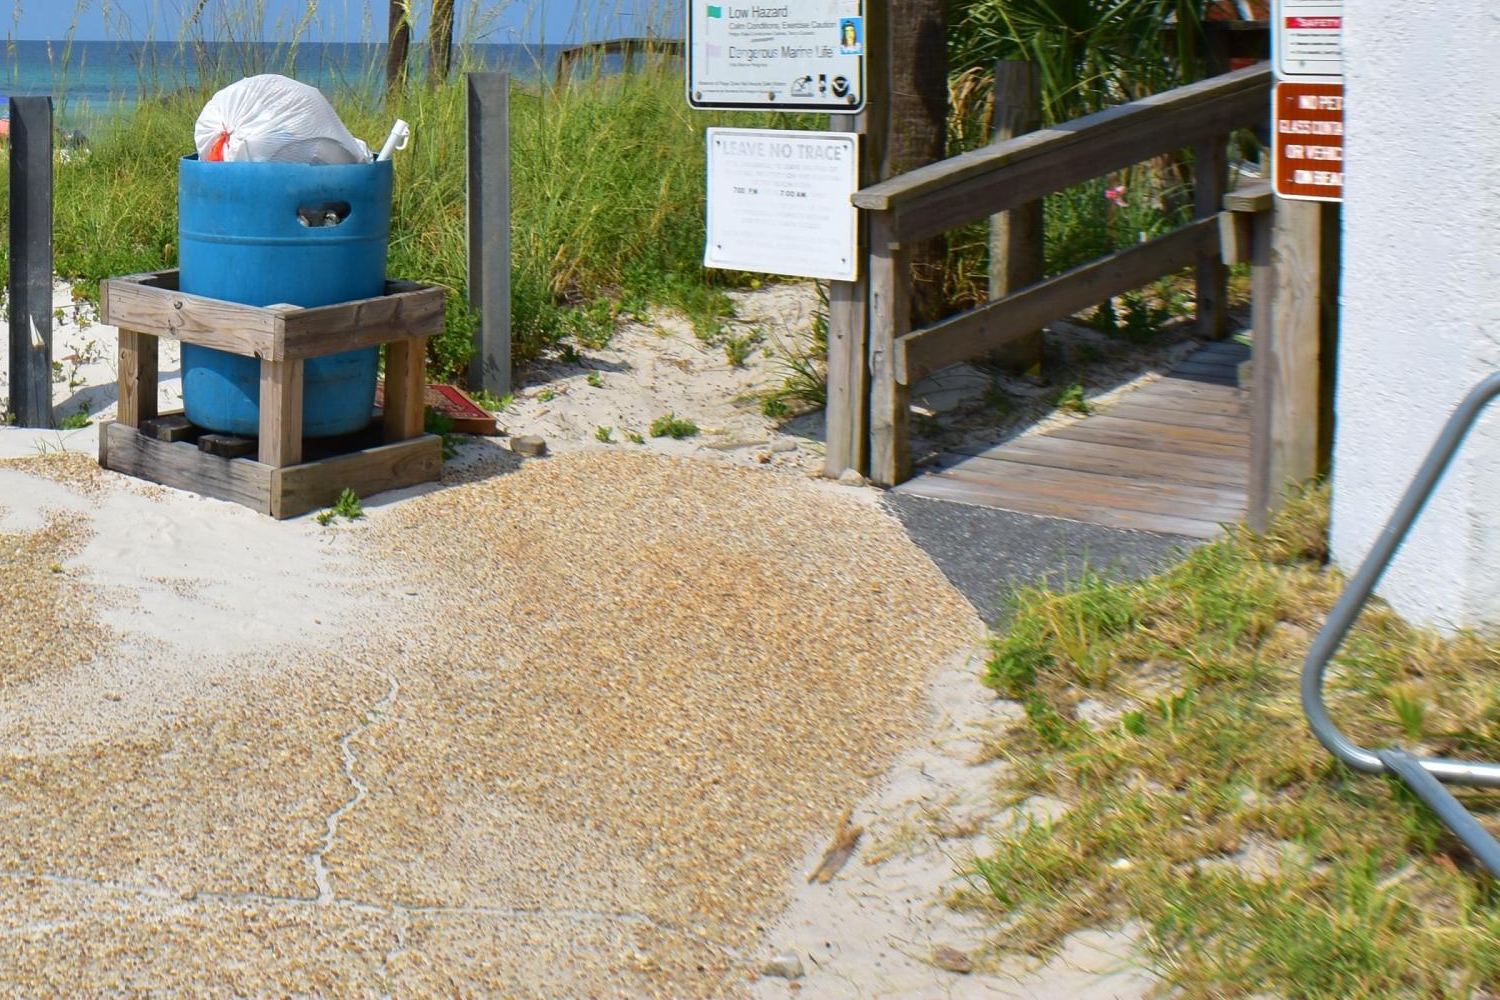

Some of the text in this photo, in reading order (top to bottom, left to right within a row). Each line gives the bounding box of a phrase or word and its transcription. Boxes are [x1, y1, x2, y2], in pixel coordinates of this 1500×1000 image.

[728, 5, 788, 19] Low Hazard
[728, 45, 834, 61] Dangerous Marine Life
[1299, 95, 1317, 109] NO
[1279, 119, 1311, 134] GLASS
[723, 140, 842, 161] LEAVE NO TRACE
[1285, 144, 1305, 159] OR
[1293, 169, 1312, 184] ON
